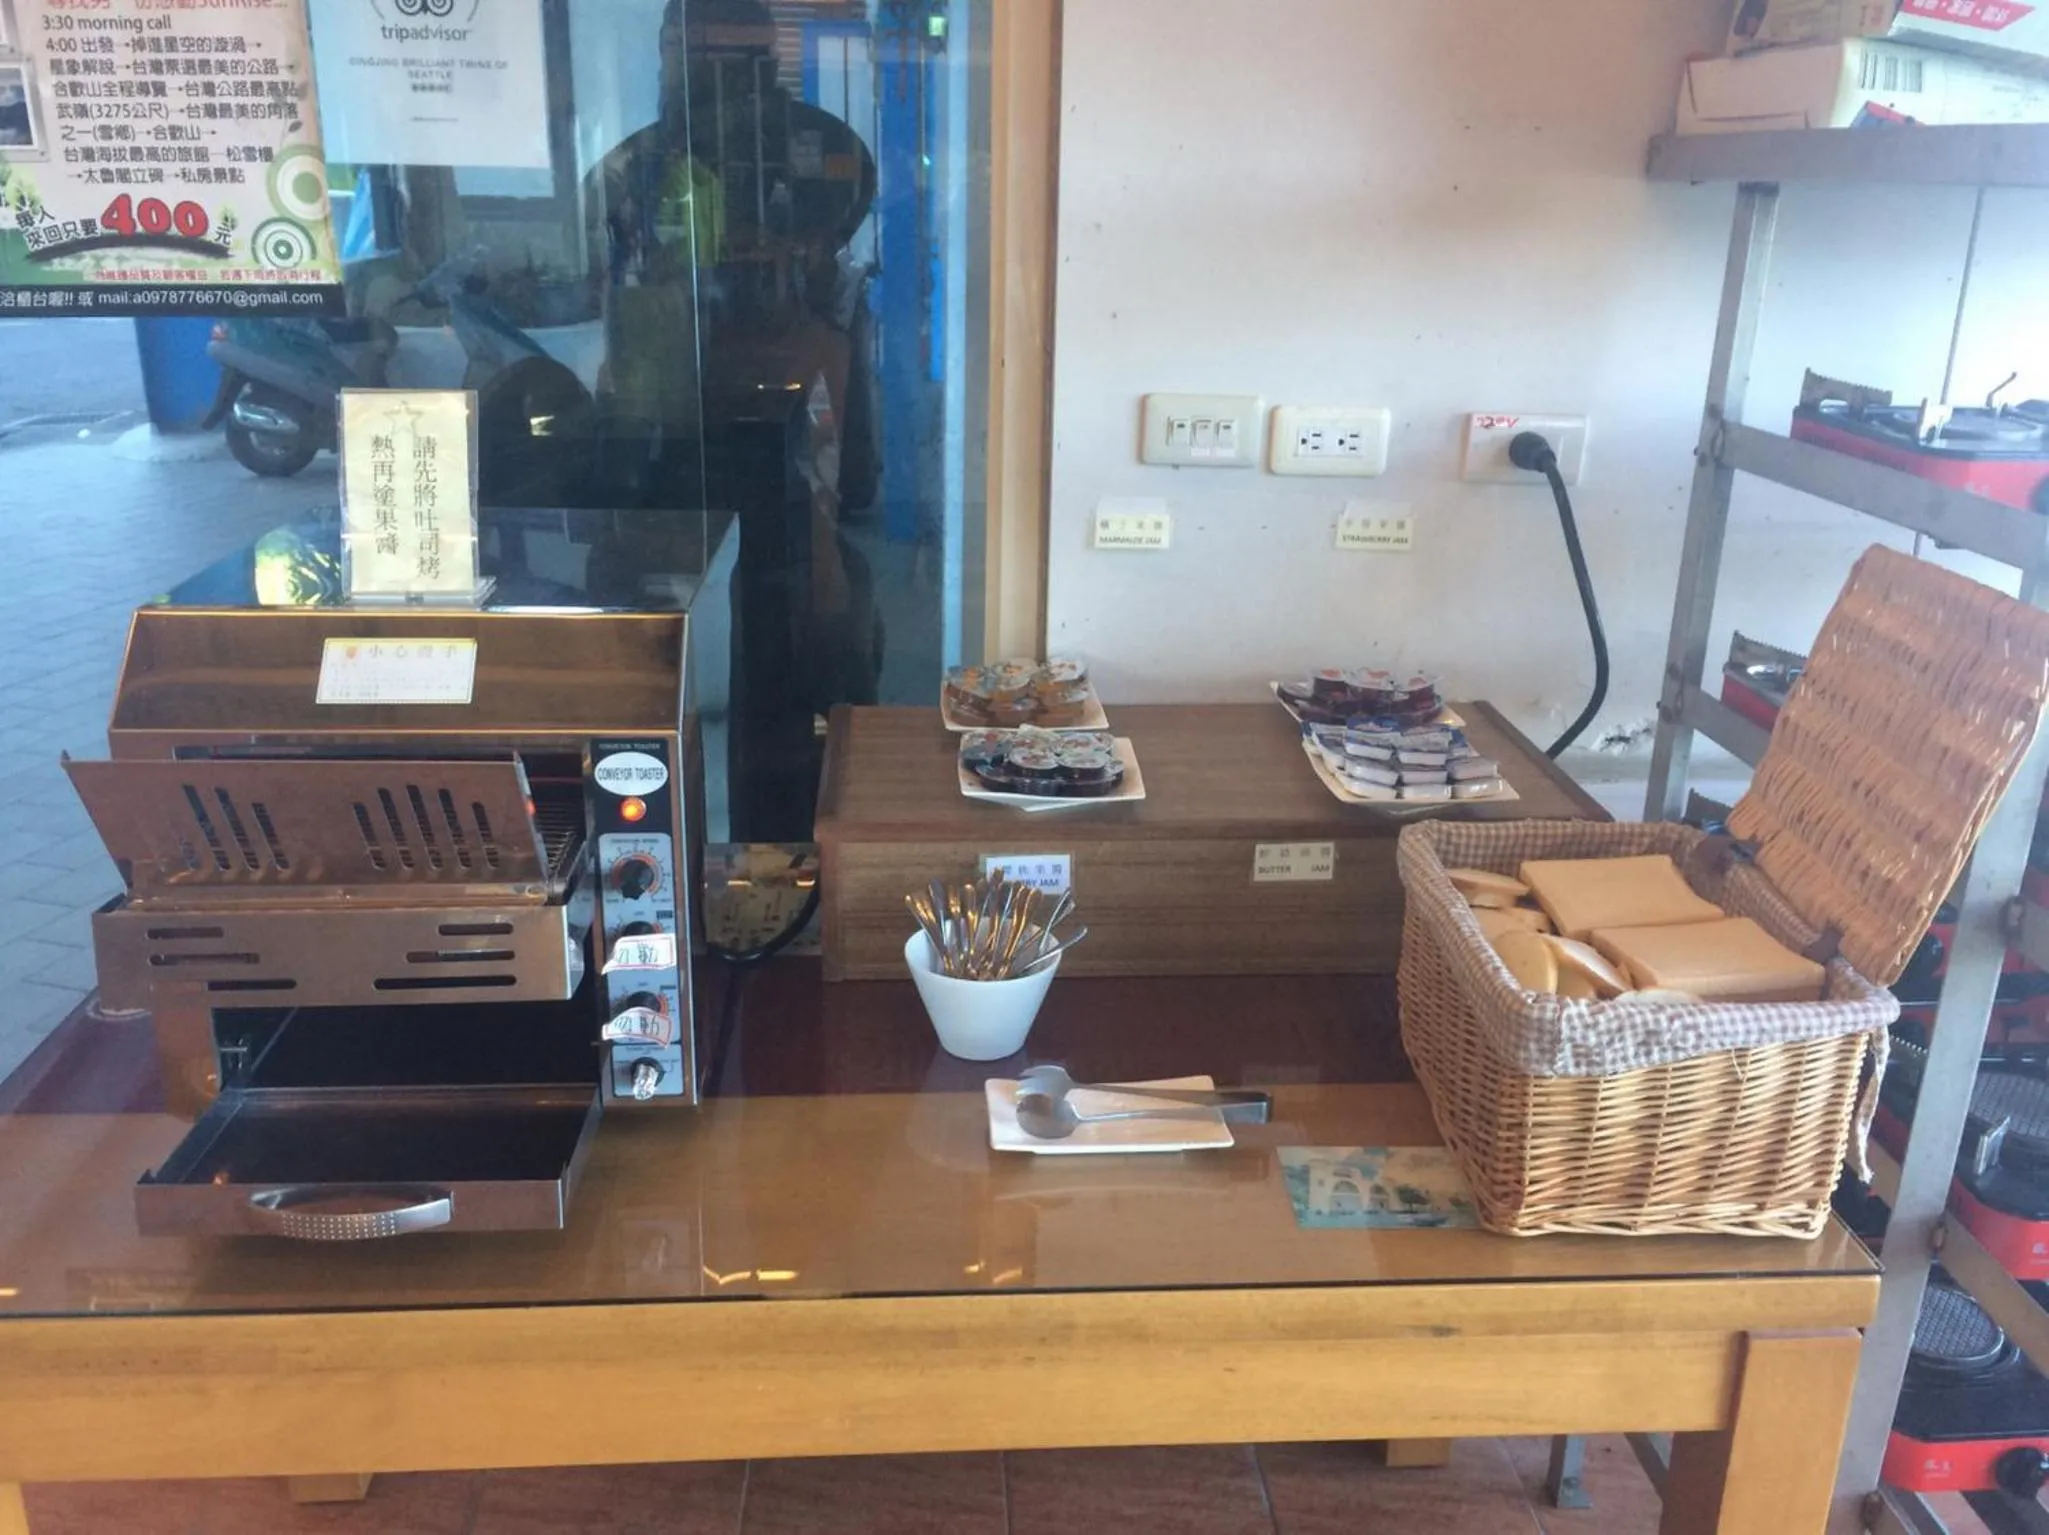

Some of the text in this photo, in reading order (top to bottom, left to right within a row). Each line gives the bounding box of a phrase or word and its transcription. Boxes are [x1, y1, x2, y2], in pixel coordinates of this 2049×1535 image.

[42, 15, 172, 33] 3:30 morning call
[380, 24, 469, 43] tripadvisor
[46, 37, 77, 51] 4:00
[81, 36, 114, 53] 出發
[495, 60, 508, 69] OF
[408, 70, 453, 79] SEATTLE
[15, 203, 55, 229] 每人
[26, 217, 99, 250] 來回只要
[101, 193, 209, 237] 400
[78, 291, 95, 306] 或
[371, 434, 399, 555] 熱再塗果醬
[413, 435, 440, 579] 請先將吐司烤
[597, 767, 665, 781] CONVEYOR TOASTER
[1258, 863, 1331, 875] BUTTER JAM
